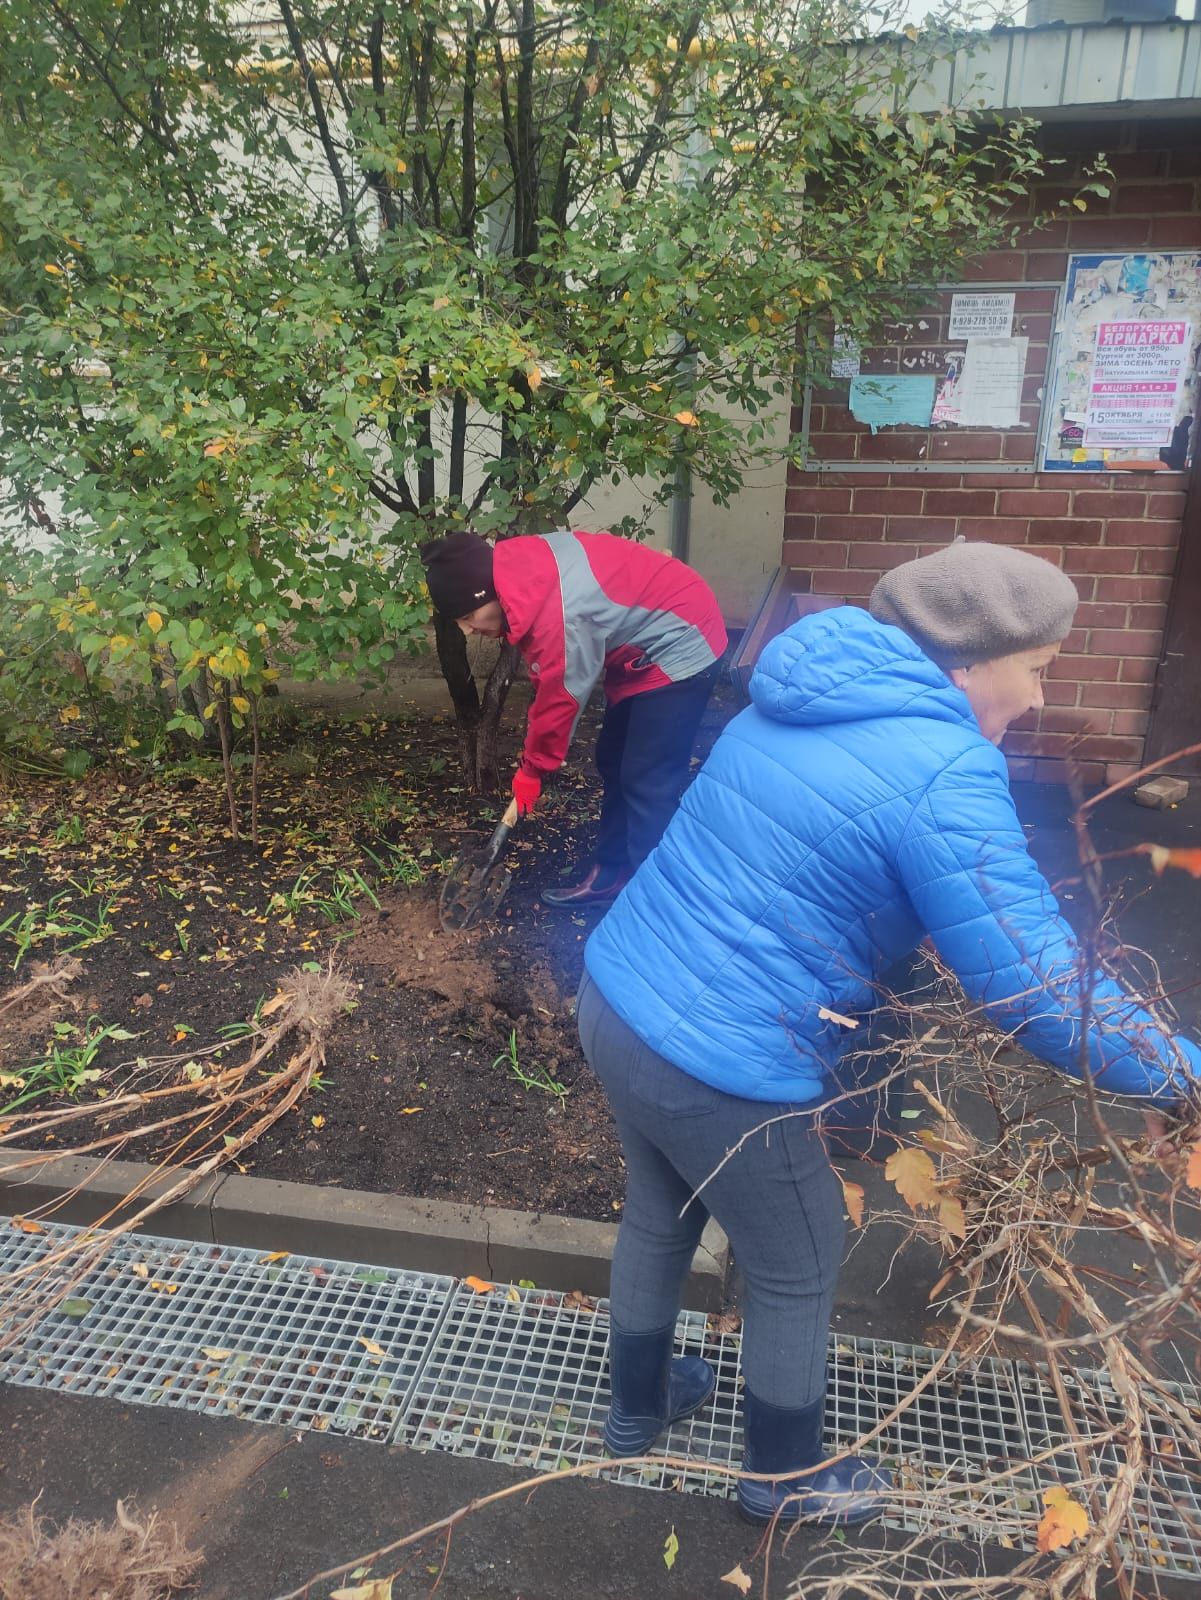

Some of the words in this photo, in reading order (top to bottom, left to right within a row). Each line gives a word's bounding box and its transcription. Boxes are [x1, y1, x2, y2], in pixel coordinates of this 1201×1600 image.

[1104, 324, 1181, 333] БЕЛОРУССКАЯ
[1103, 332, 1179, 345] ЯРМАРКА
[1113, 346, 1137, 354] обувь
[1101, 384, 1132, 392] АКЦИЯ
[1089, 411, 1105, 424] 15
